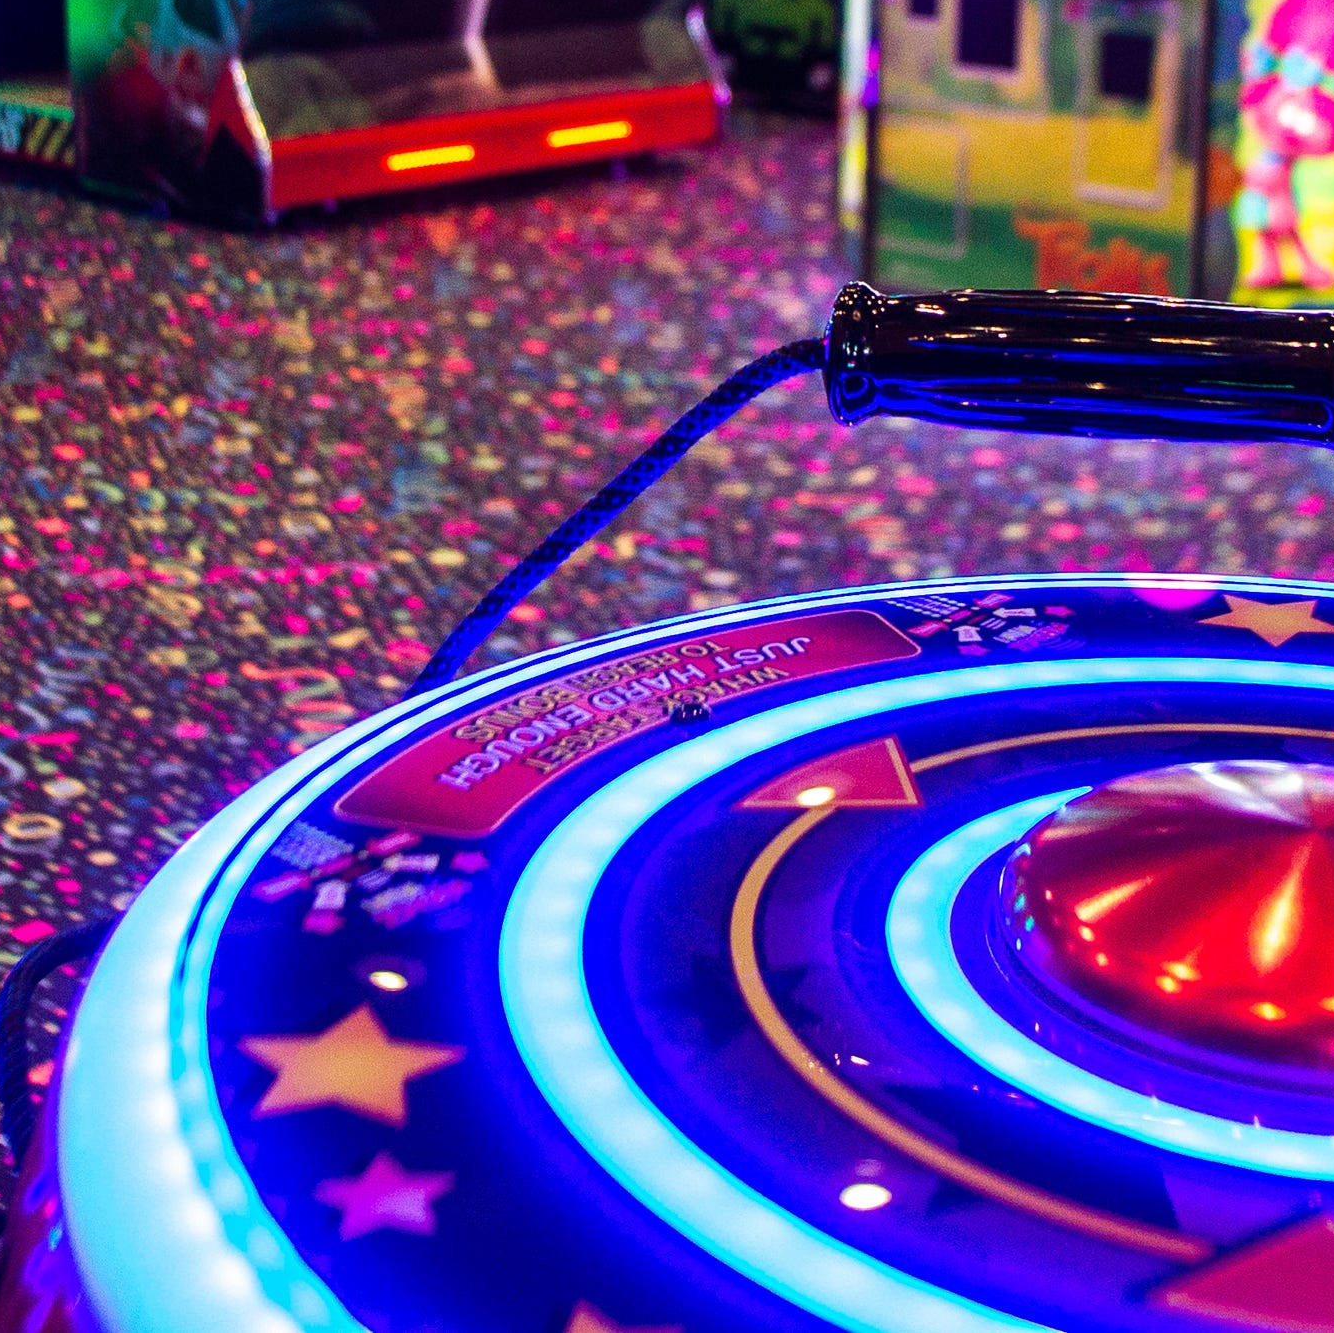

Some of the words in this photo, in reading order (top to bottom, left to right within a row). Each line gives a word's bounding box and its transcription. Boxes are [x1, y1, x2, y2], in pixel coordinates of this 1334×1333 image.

[570, 650, 681, 692] REACH
[677, 639, 731, 658] TO
[713, 636, 814, 673] JUST
[590, 663, 708, 712] HARD
[452, 684, 579, 745] BONUS
[434, 706, 595, 793] ENOUGH
